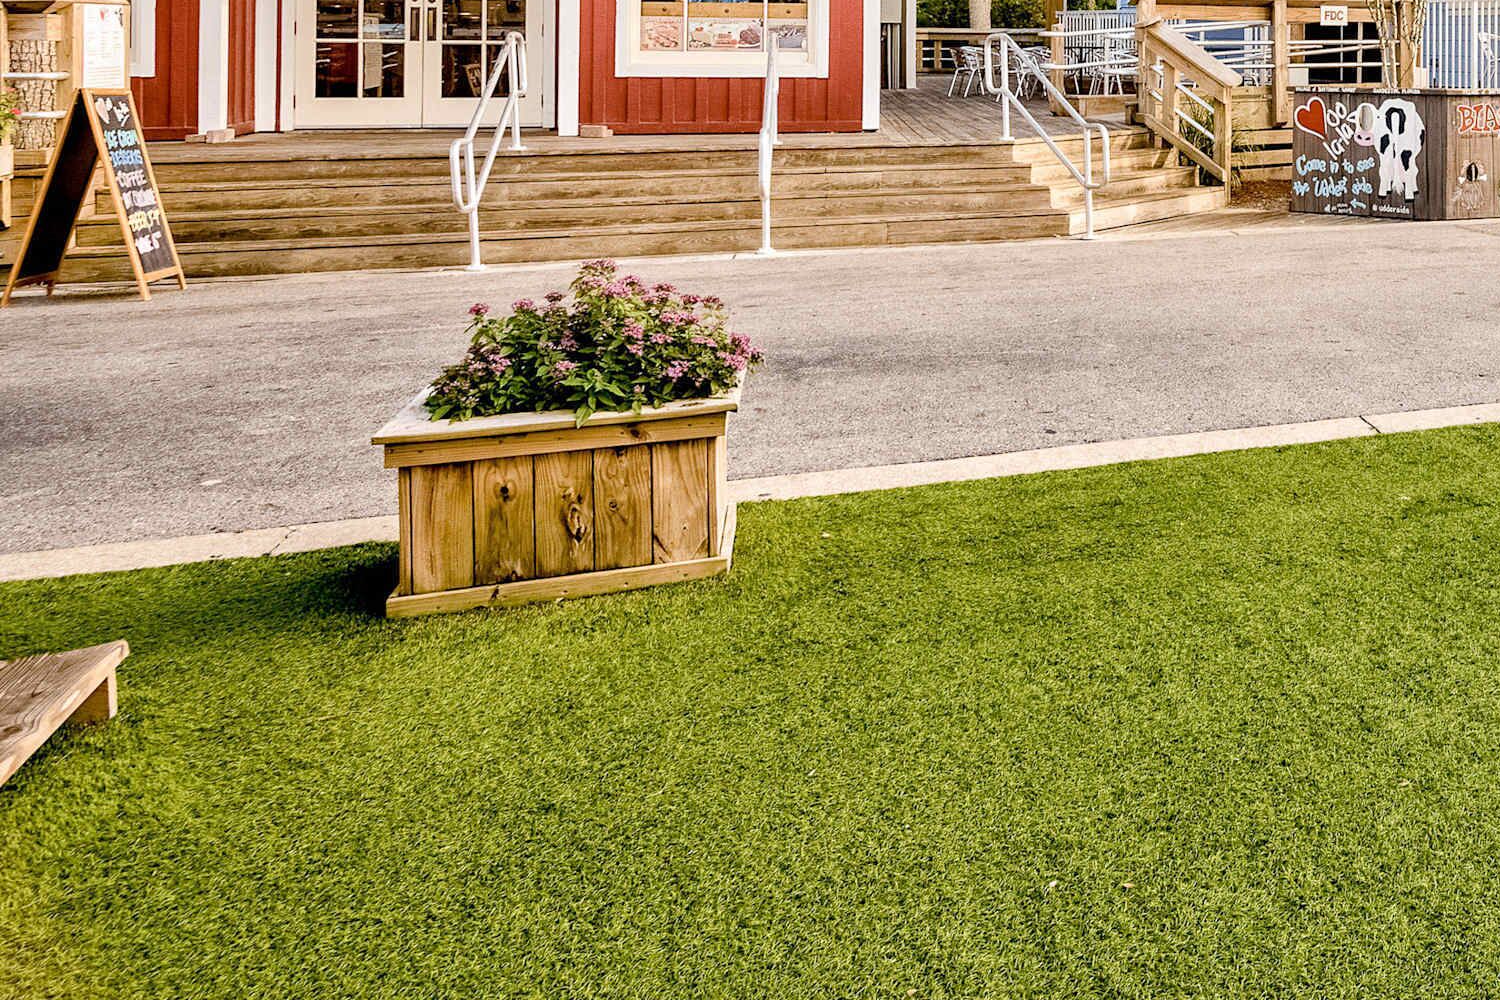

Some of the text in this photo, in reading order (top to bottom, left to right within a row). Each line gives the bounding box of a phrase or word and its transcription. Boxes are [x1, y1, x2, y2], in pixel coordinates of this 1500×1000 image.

[1324, 10, 1344, 21] FDC
[1295, 154, 1376, 176] Come in to see
